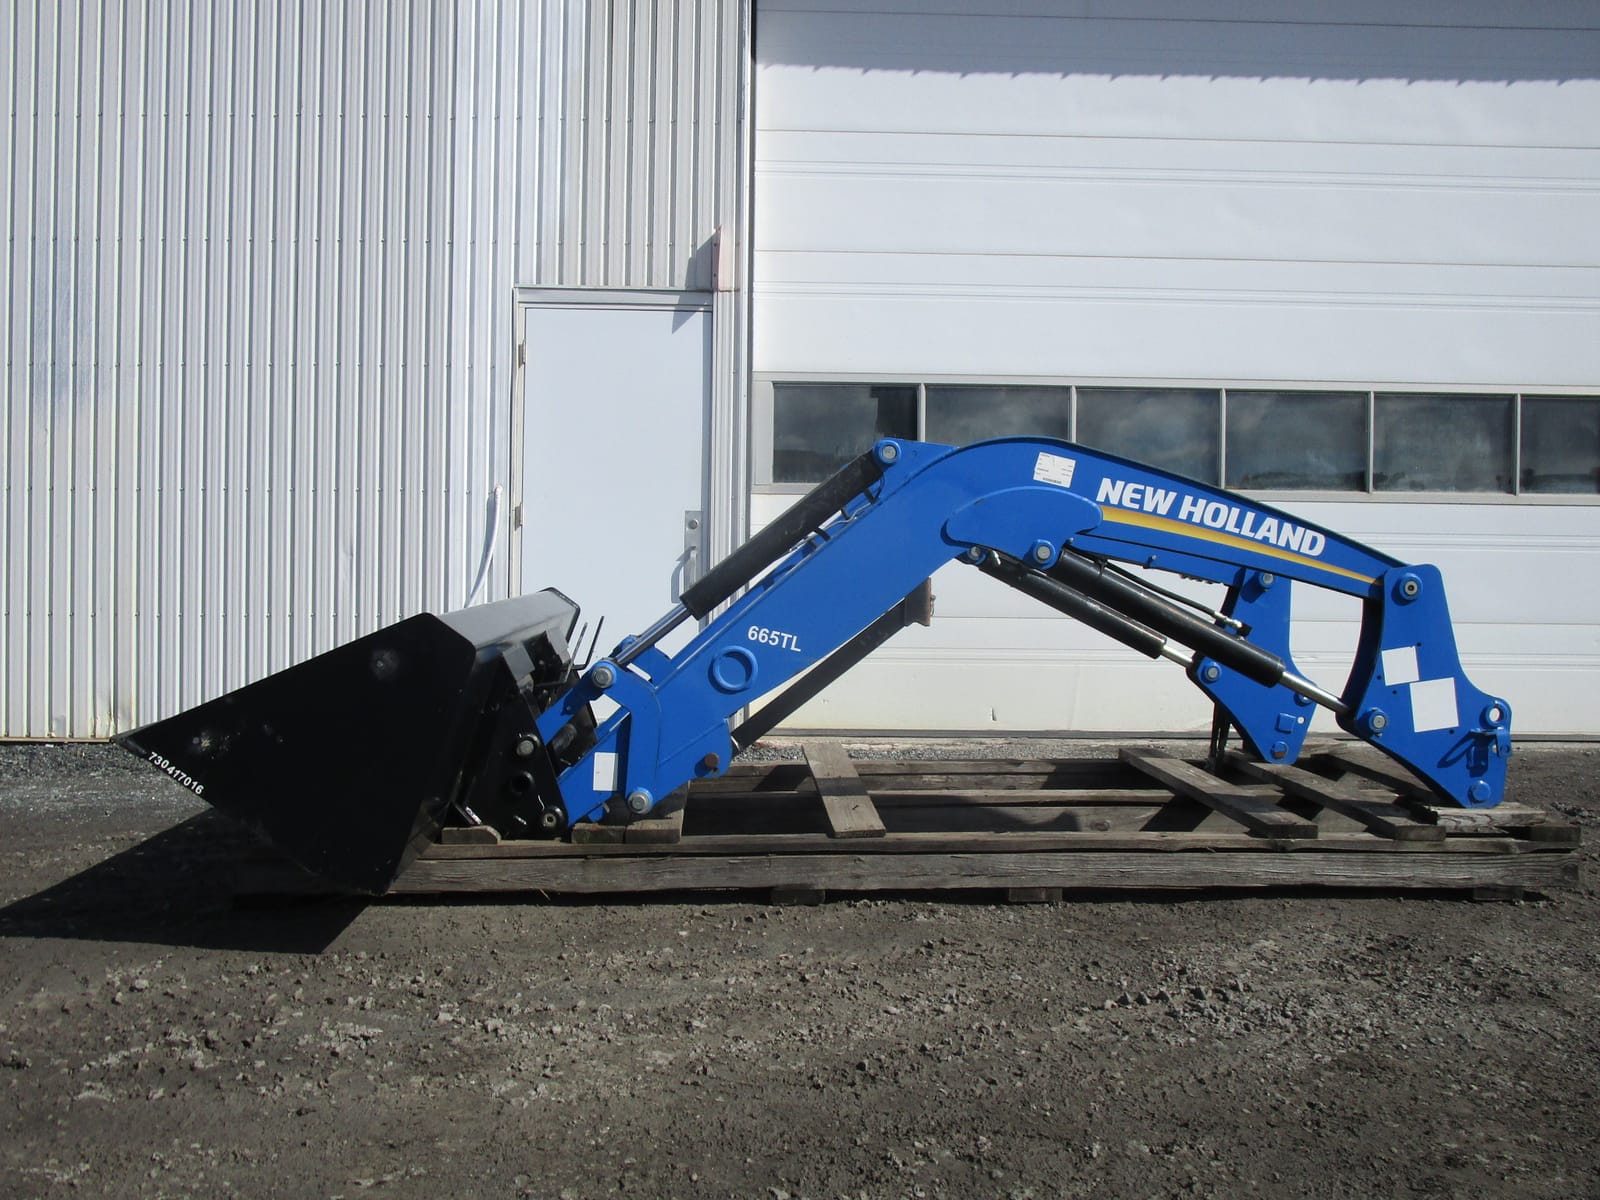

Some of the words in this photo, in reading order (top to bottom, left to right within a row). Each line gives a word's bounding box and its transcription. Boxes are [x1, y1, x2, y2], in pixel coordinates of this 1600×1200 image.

[1096, 477, 1177, 516] NEW
[1179, 494, 1326, 557] HOLLAND
[747, 625, 802, 653] 665TL
[148, 751, 205, 795] 730417016
